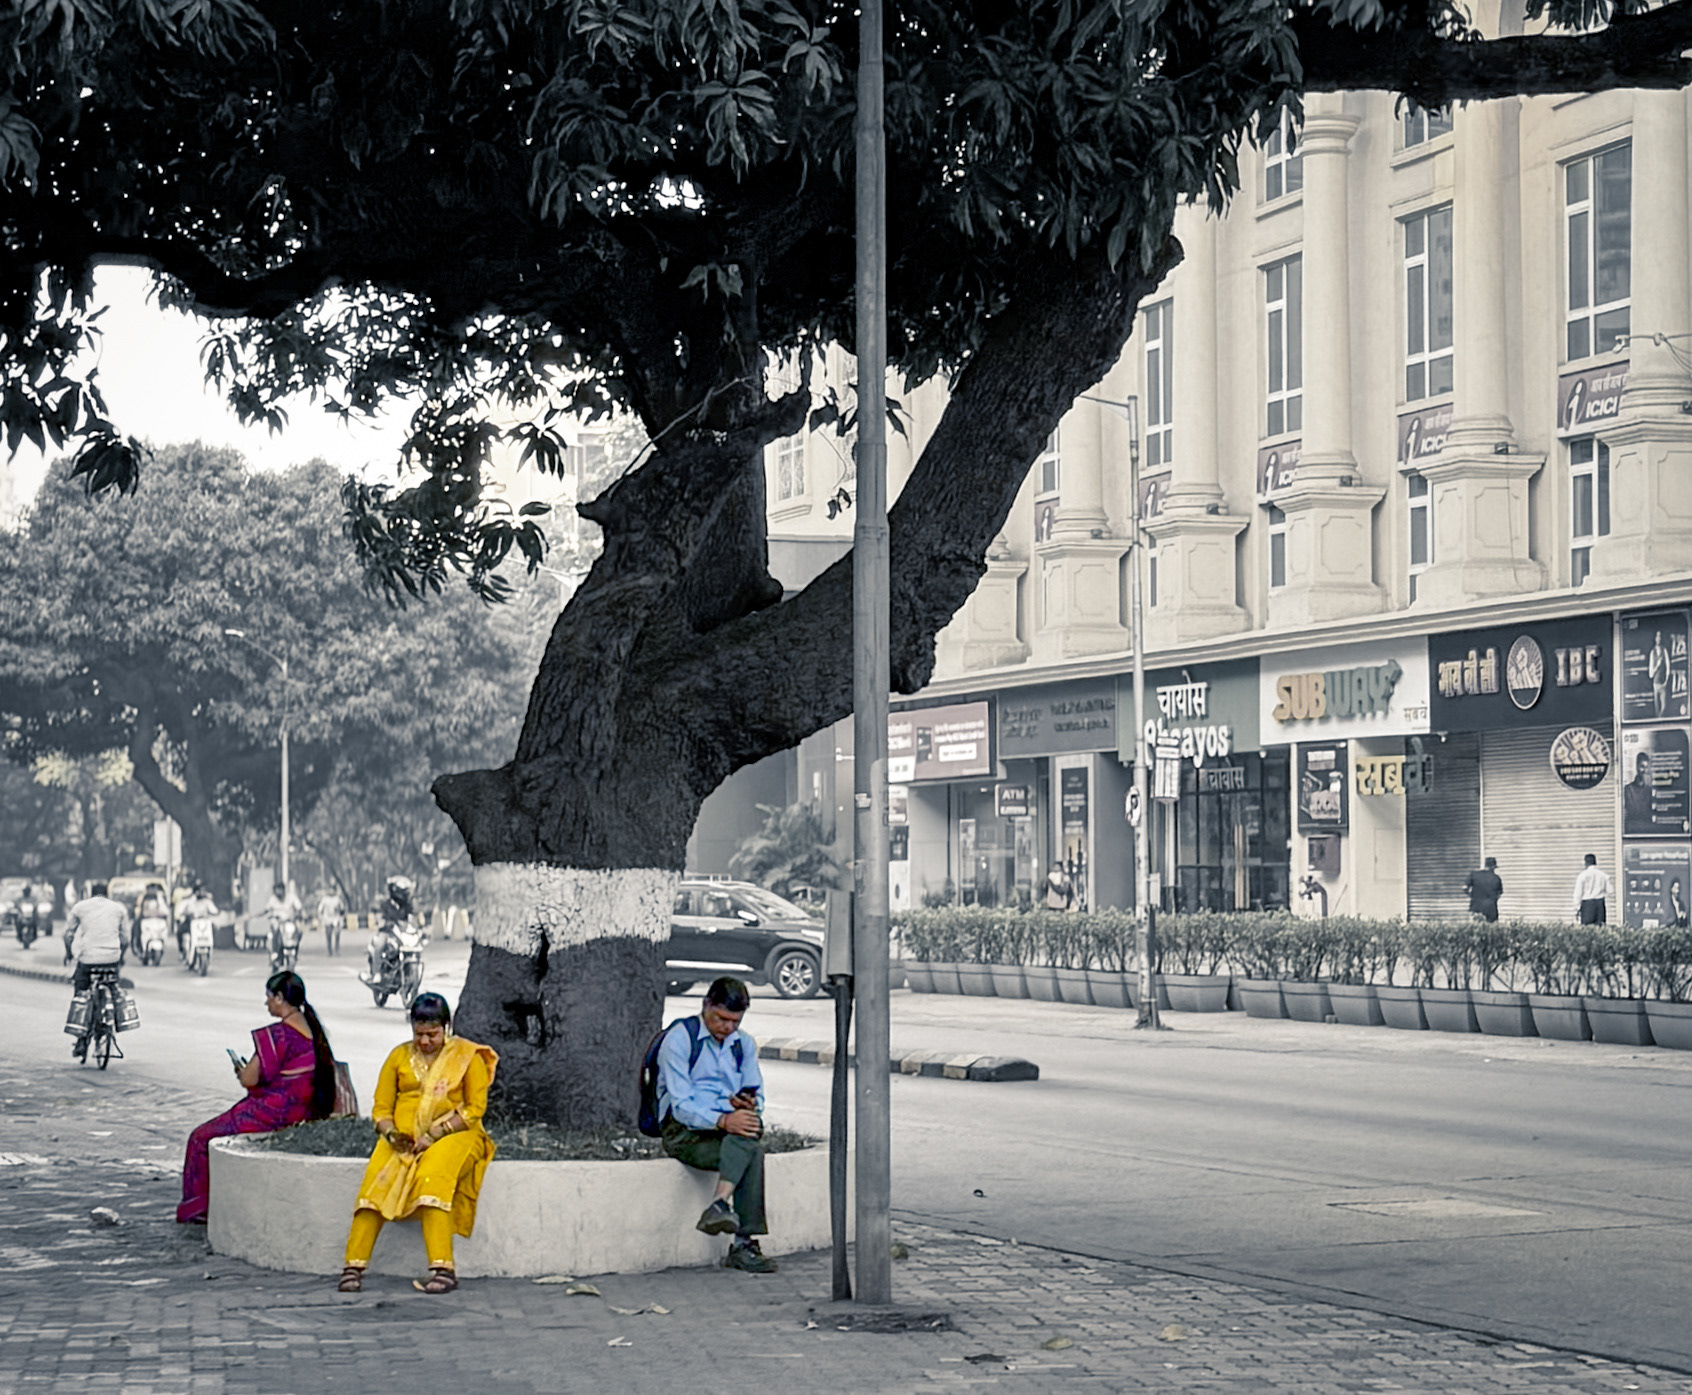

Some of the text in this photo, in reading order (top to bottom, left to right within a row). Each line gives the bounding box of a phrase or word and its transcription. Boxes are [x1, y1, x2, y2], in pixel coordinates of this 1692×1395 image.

[1586, 396, 1619, 419] ICICI
[1555, 645, 1601, 686] IBC
[1156, 670, 1208, 719] चायोस
[1272, 659, 1403, 725] SUBWAY
[1144, 717, 1229, 768] Chayos
[1356, 737, 1432, 796] सबवे
[1002, 788, 1025, 800] ATM
